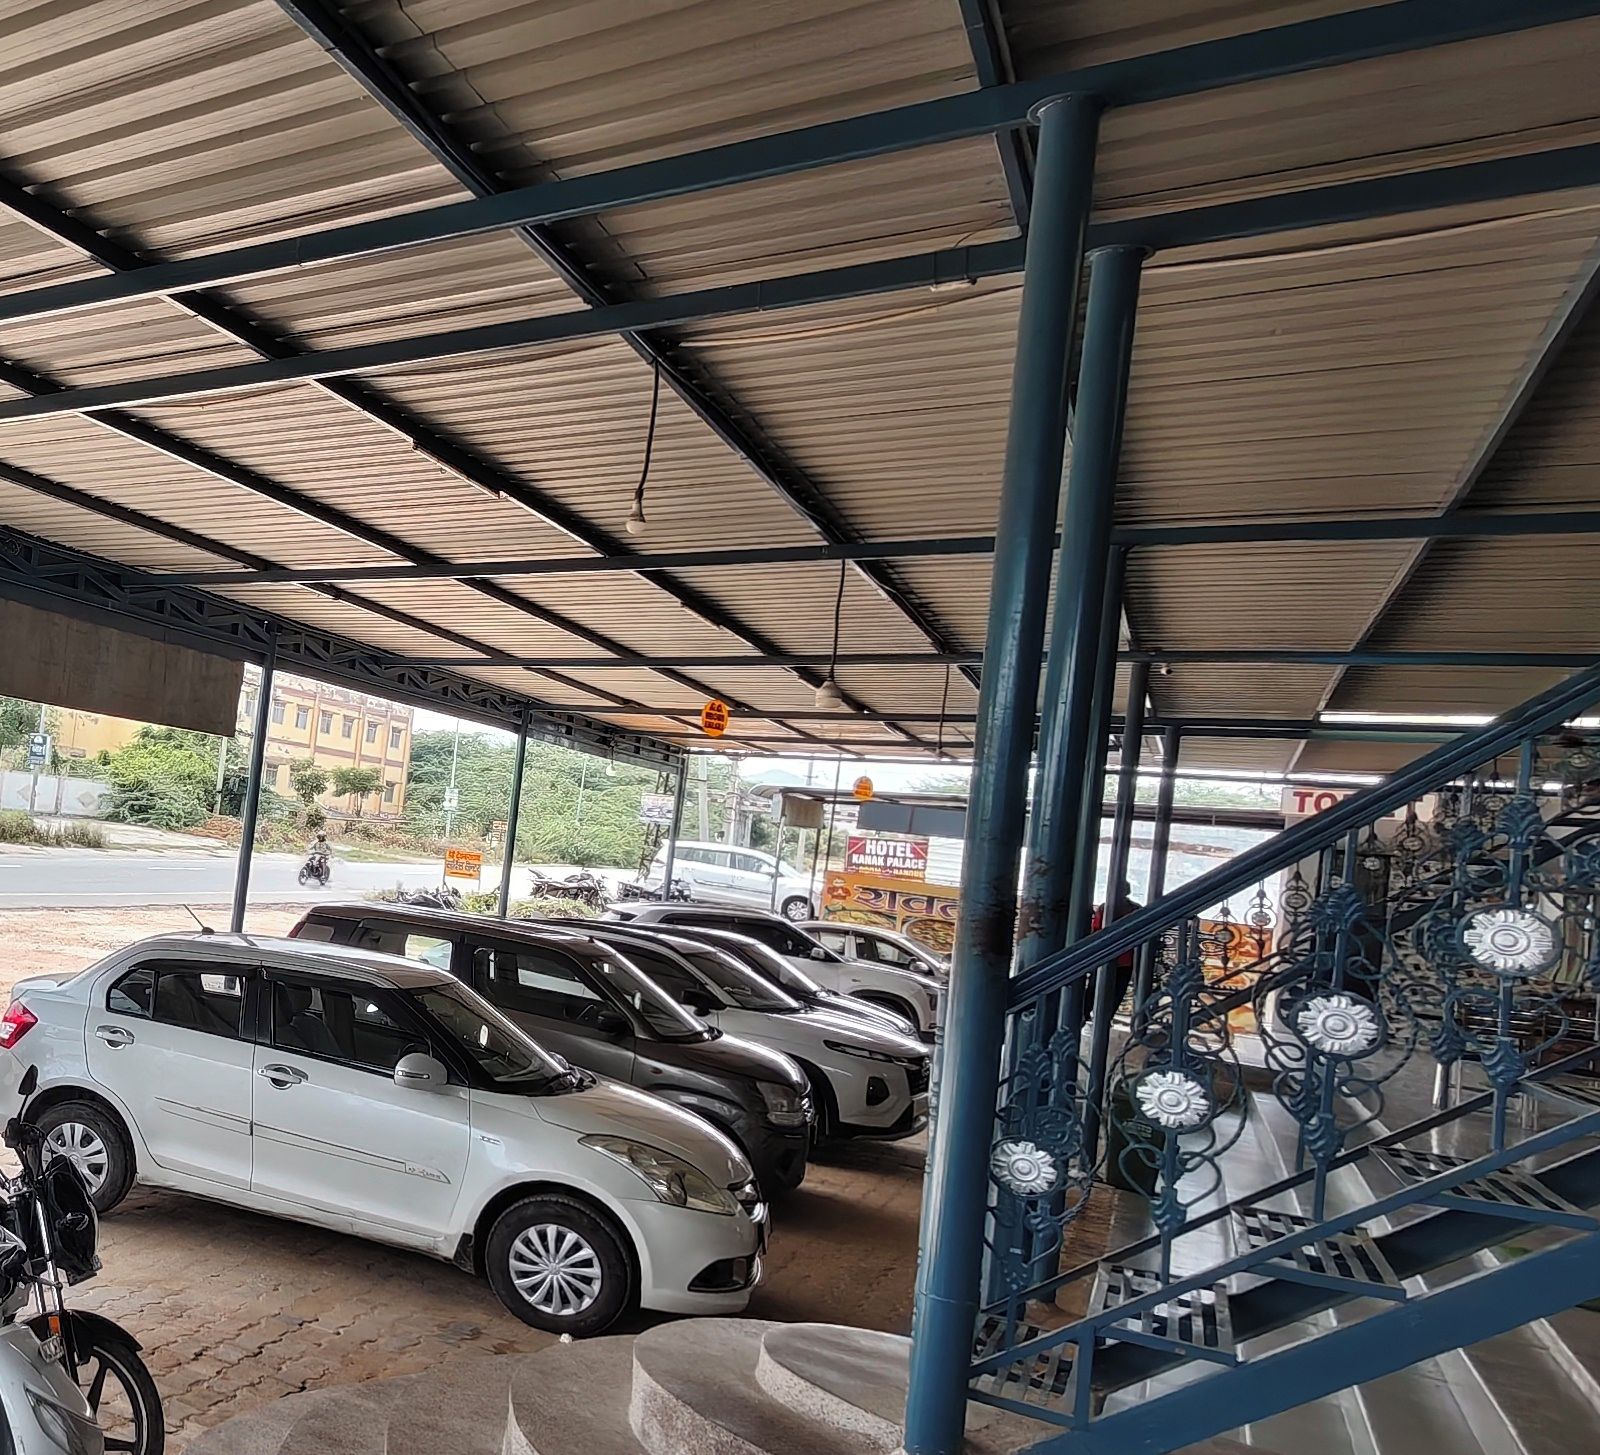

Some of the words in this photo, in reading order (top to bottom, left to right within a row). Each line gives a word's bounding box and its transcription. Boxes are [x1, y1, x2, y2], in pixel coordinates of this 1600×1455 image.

[866, 840, 914, 858] HOTEL
[852, 854, 885, 867] KANAK
[886, 857, 926, 870] PALACE
